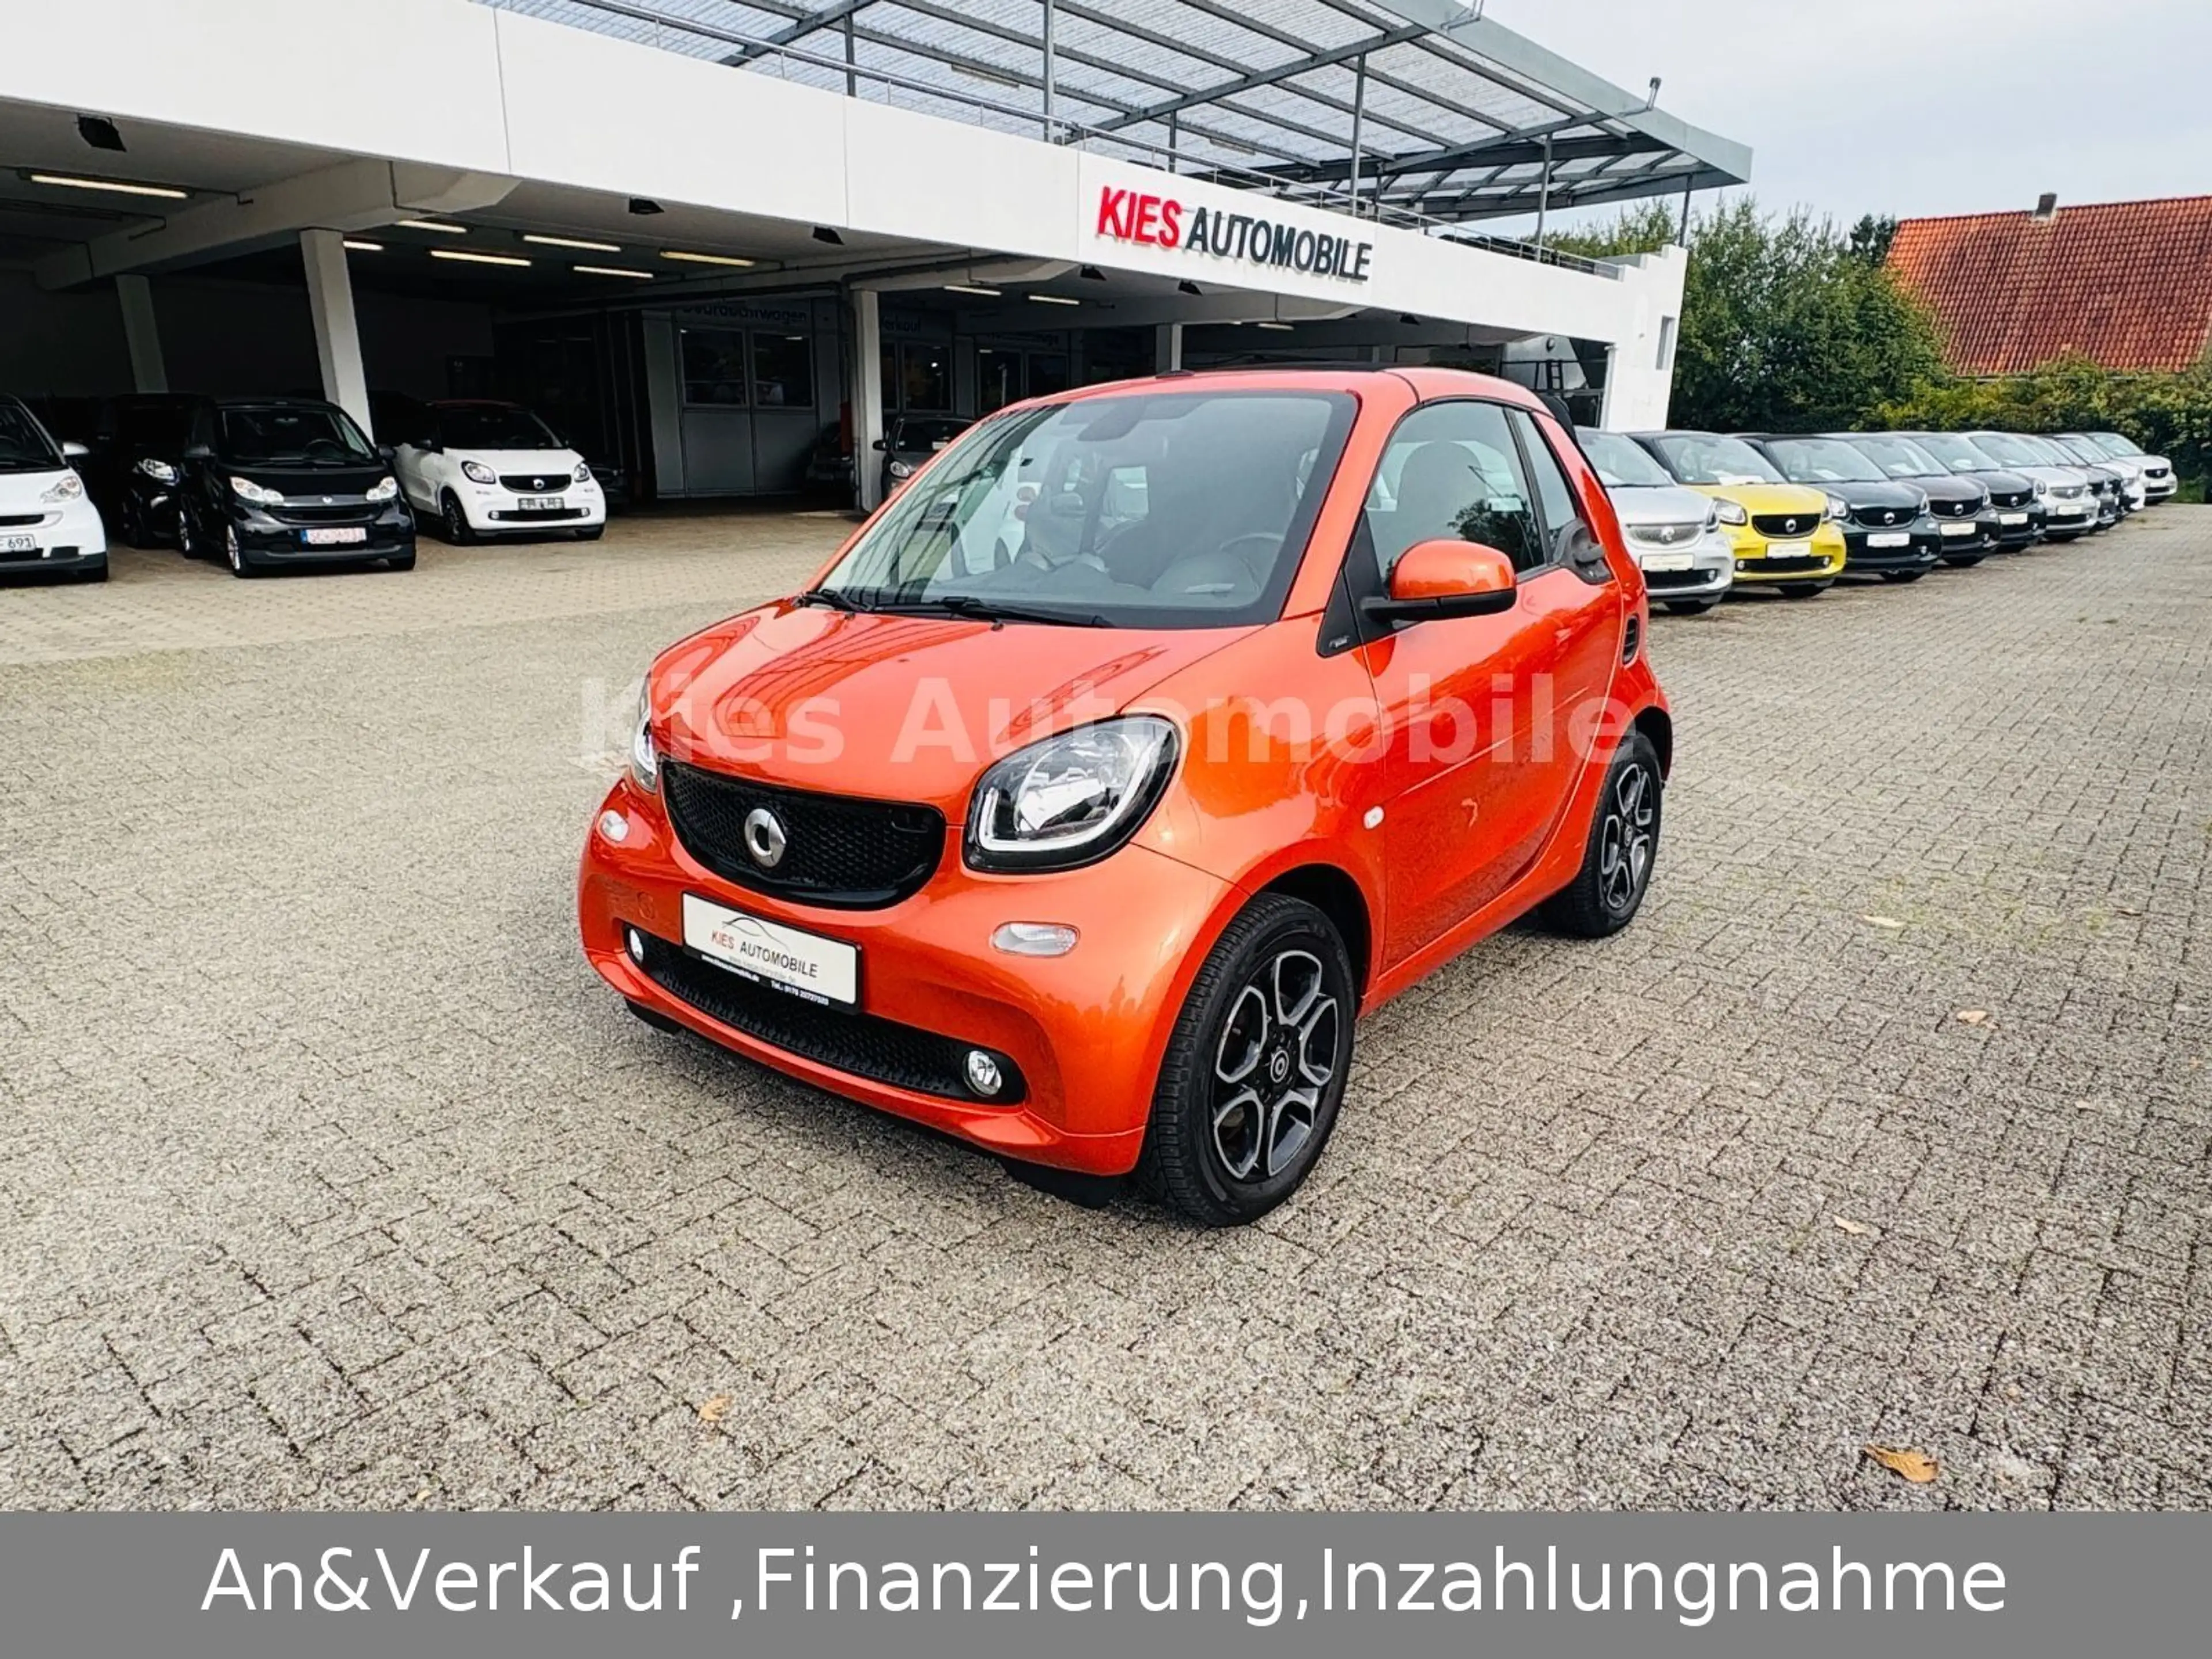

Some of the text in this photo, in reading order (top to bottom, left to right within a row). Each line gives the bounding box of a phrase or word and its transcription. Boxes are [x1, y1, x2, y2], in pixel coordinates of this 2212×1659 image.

[1098, 186, 1373, 281] KIES AUTOMOBILE
[711, 930, 735, 949] KIES
[740, 941, 819, 978] AUTOMOBILE
